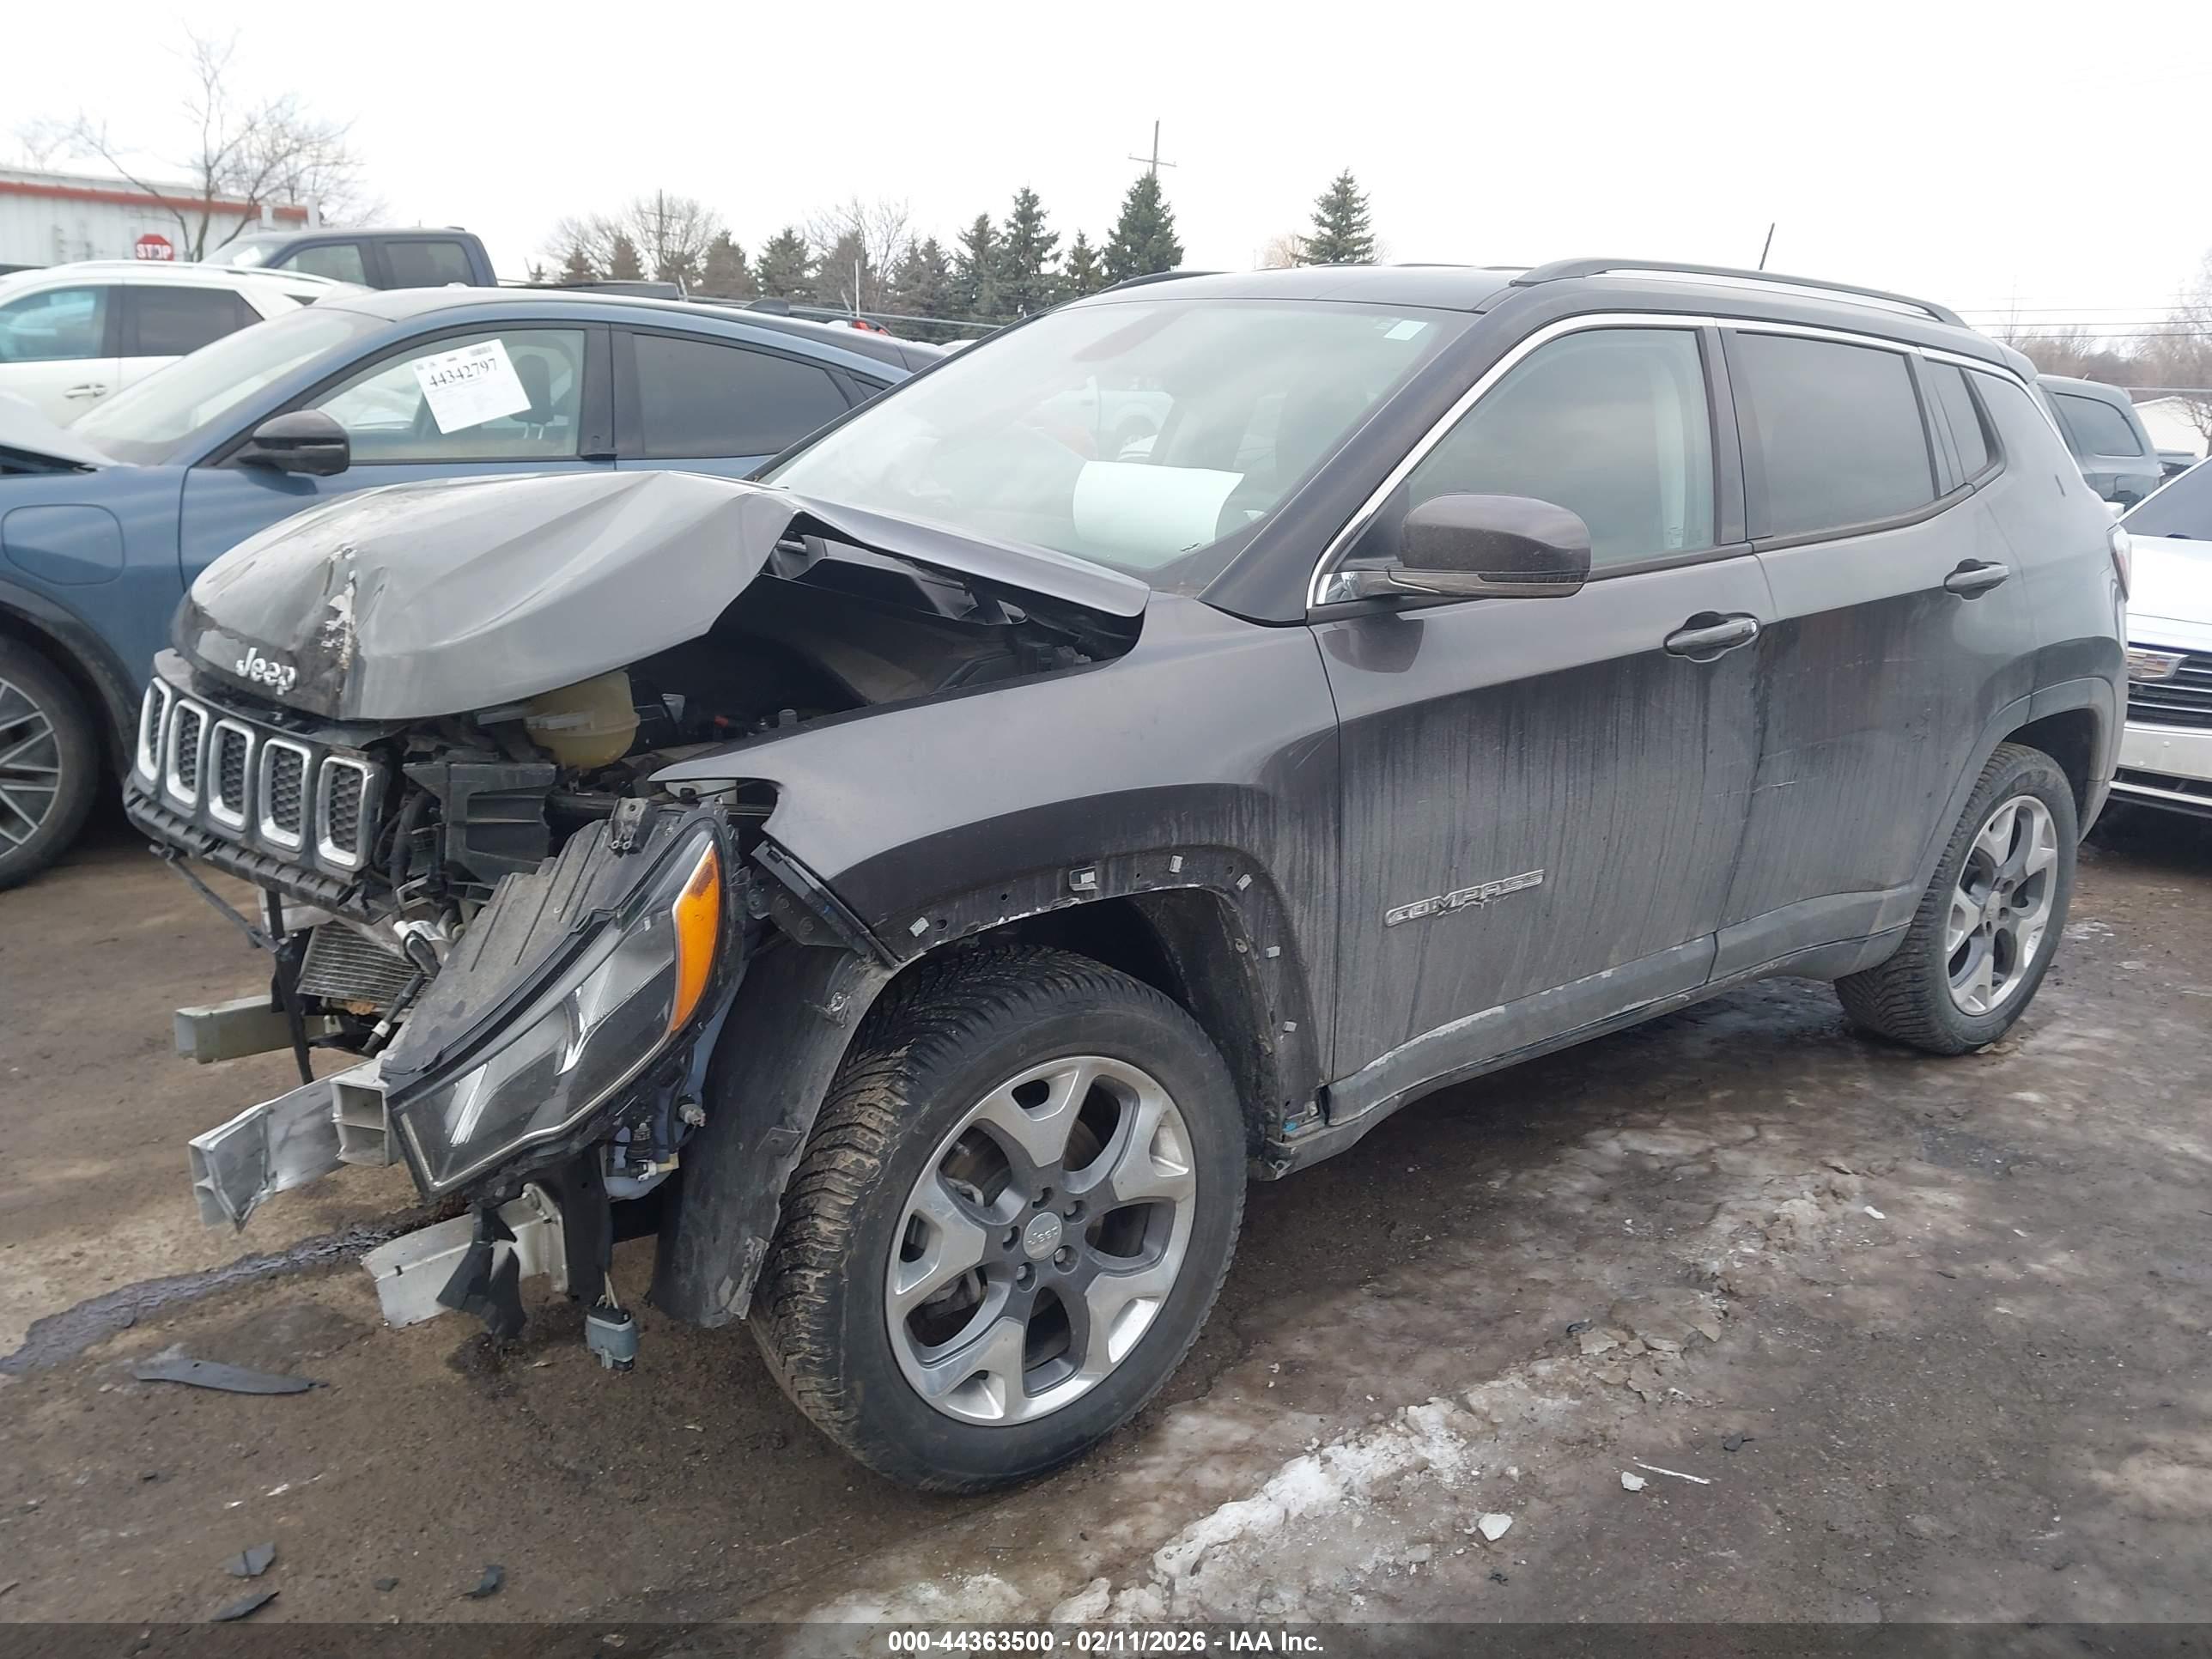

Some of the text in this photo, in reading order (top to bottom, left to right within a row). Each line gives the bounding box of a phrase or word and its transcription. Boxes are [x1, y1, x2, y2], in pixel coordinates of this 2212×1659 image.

[137, 244, 172, 259] STOP
[429, 358, 497, 386] 44342797
[235, 647, 296, 696] Jeep
[1385, 869, 1545, 927] COMPASS
